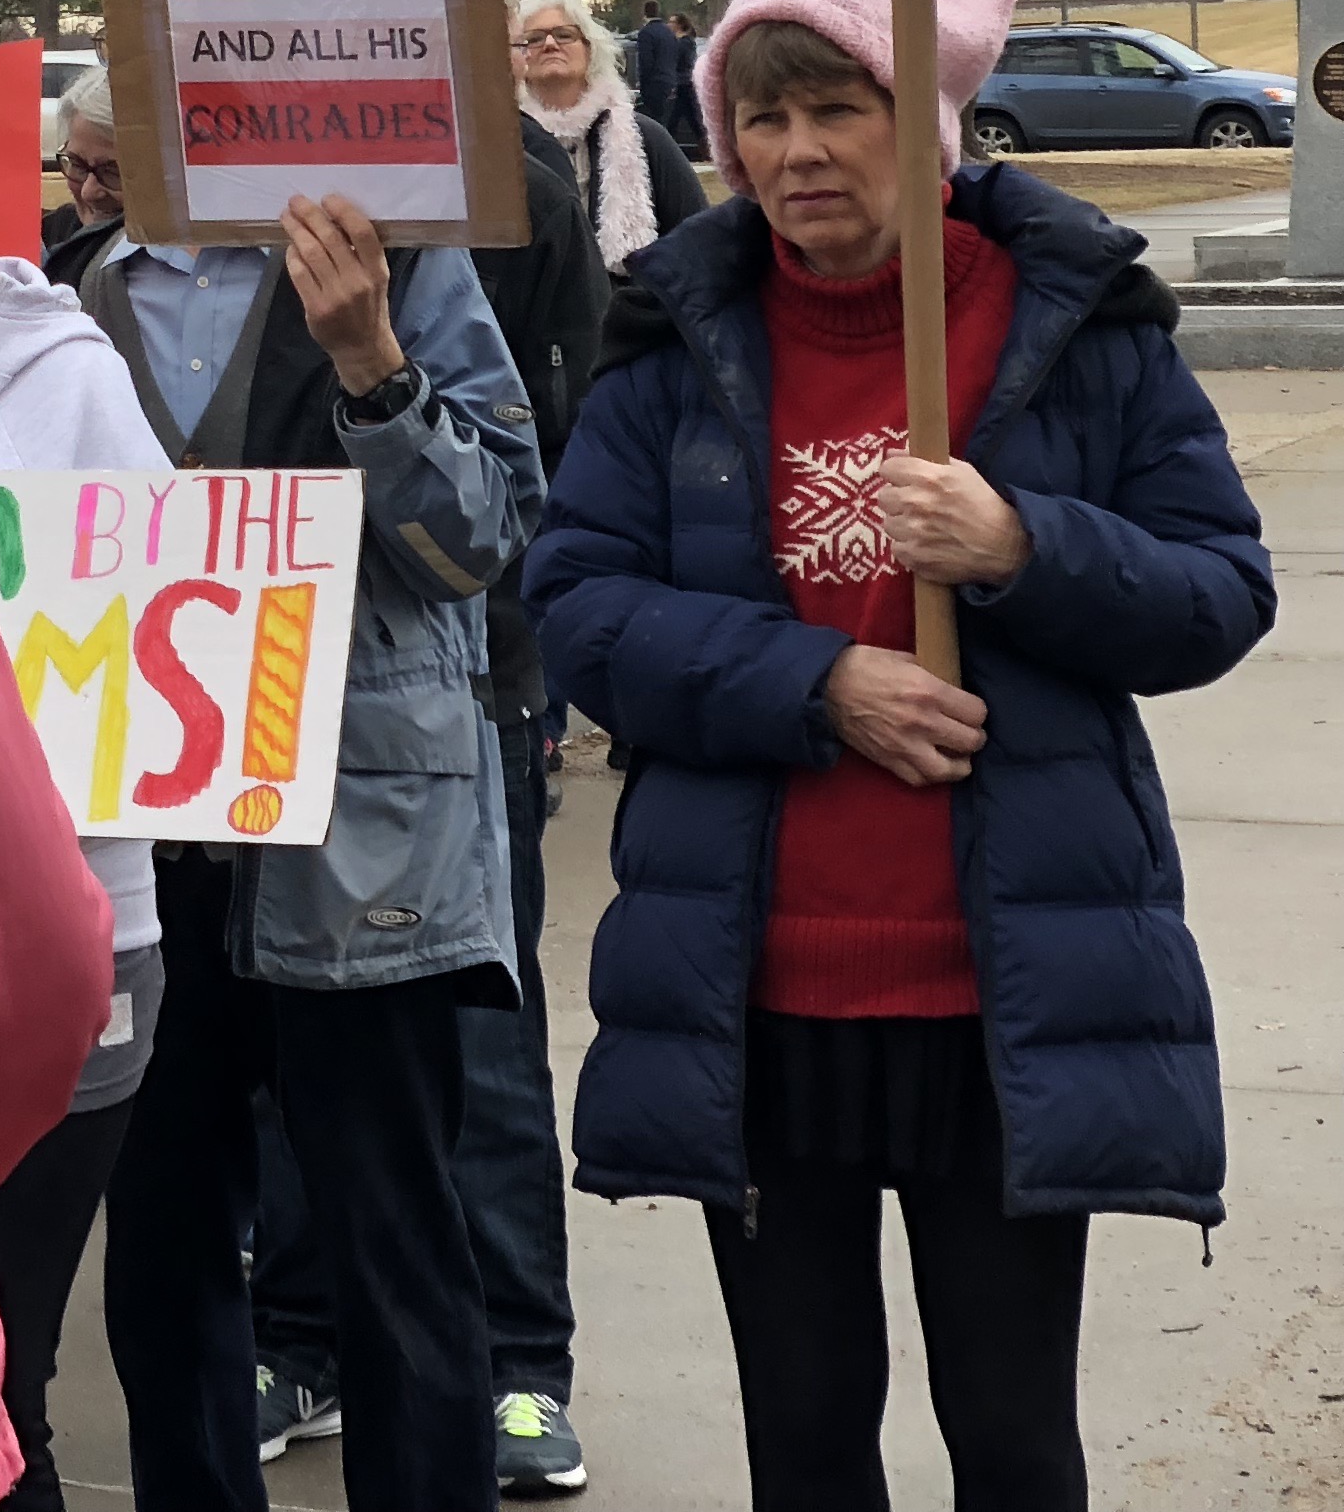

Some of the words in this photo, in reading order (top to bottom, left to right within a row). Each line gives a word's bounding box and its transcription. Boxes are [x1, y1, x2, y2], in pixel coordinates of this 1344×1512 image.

[192, 29, 274, 63] AND
[287, 28, 358, 62] ALL
[369, 27, 428, 60] HIS
[185, 103, 453, 148] COMRADES
[71, 480, 177, 579] BY
[192, 472, 343, 576] THE
